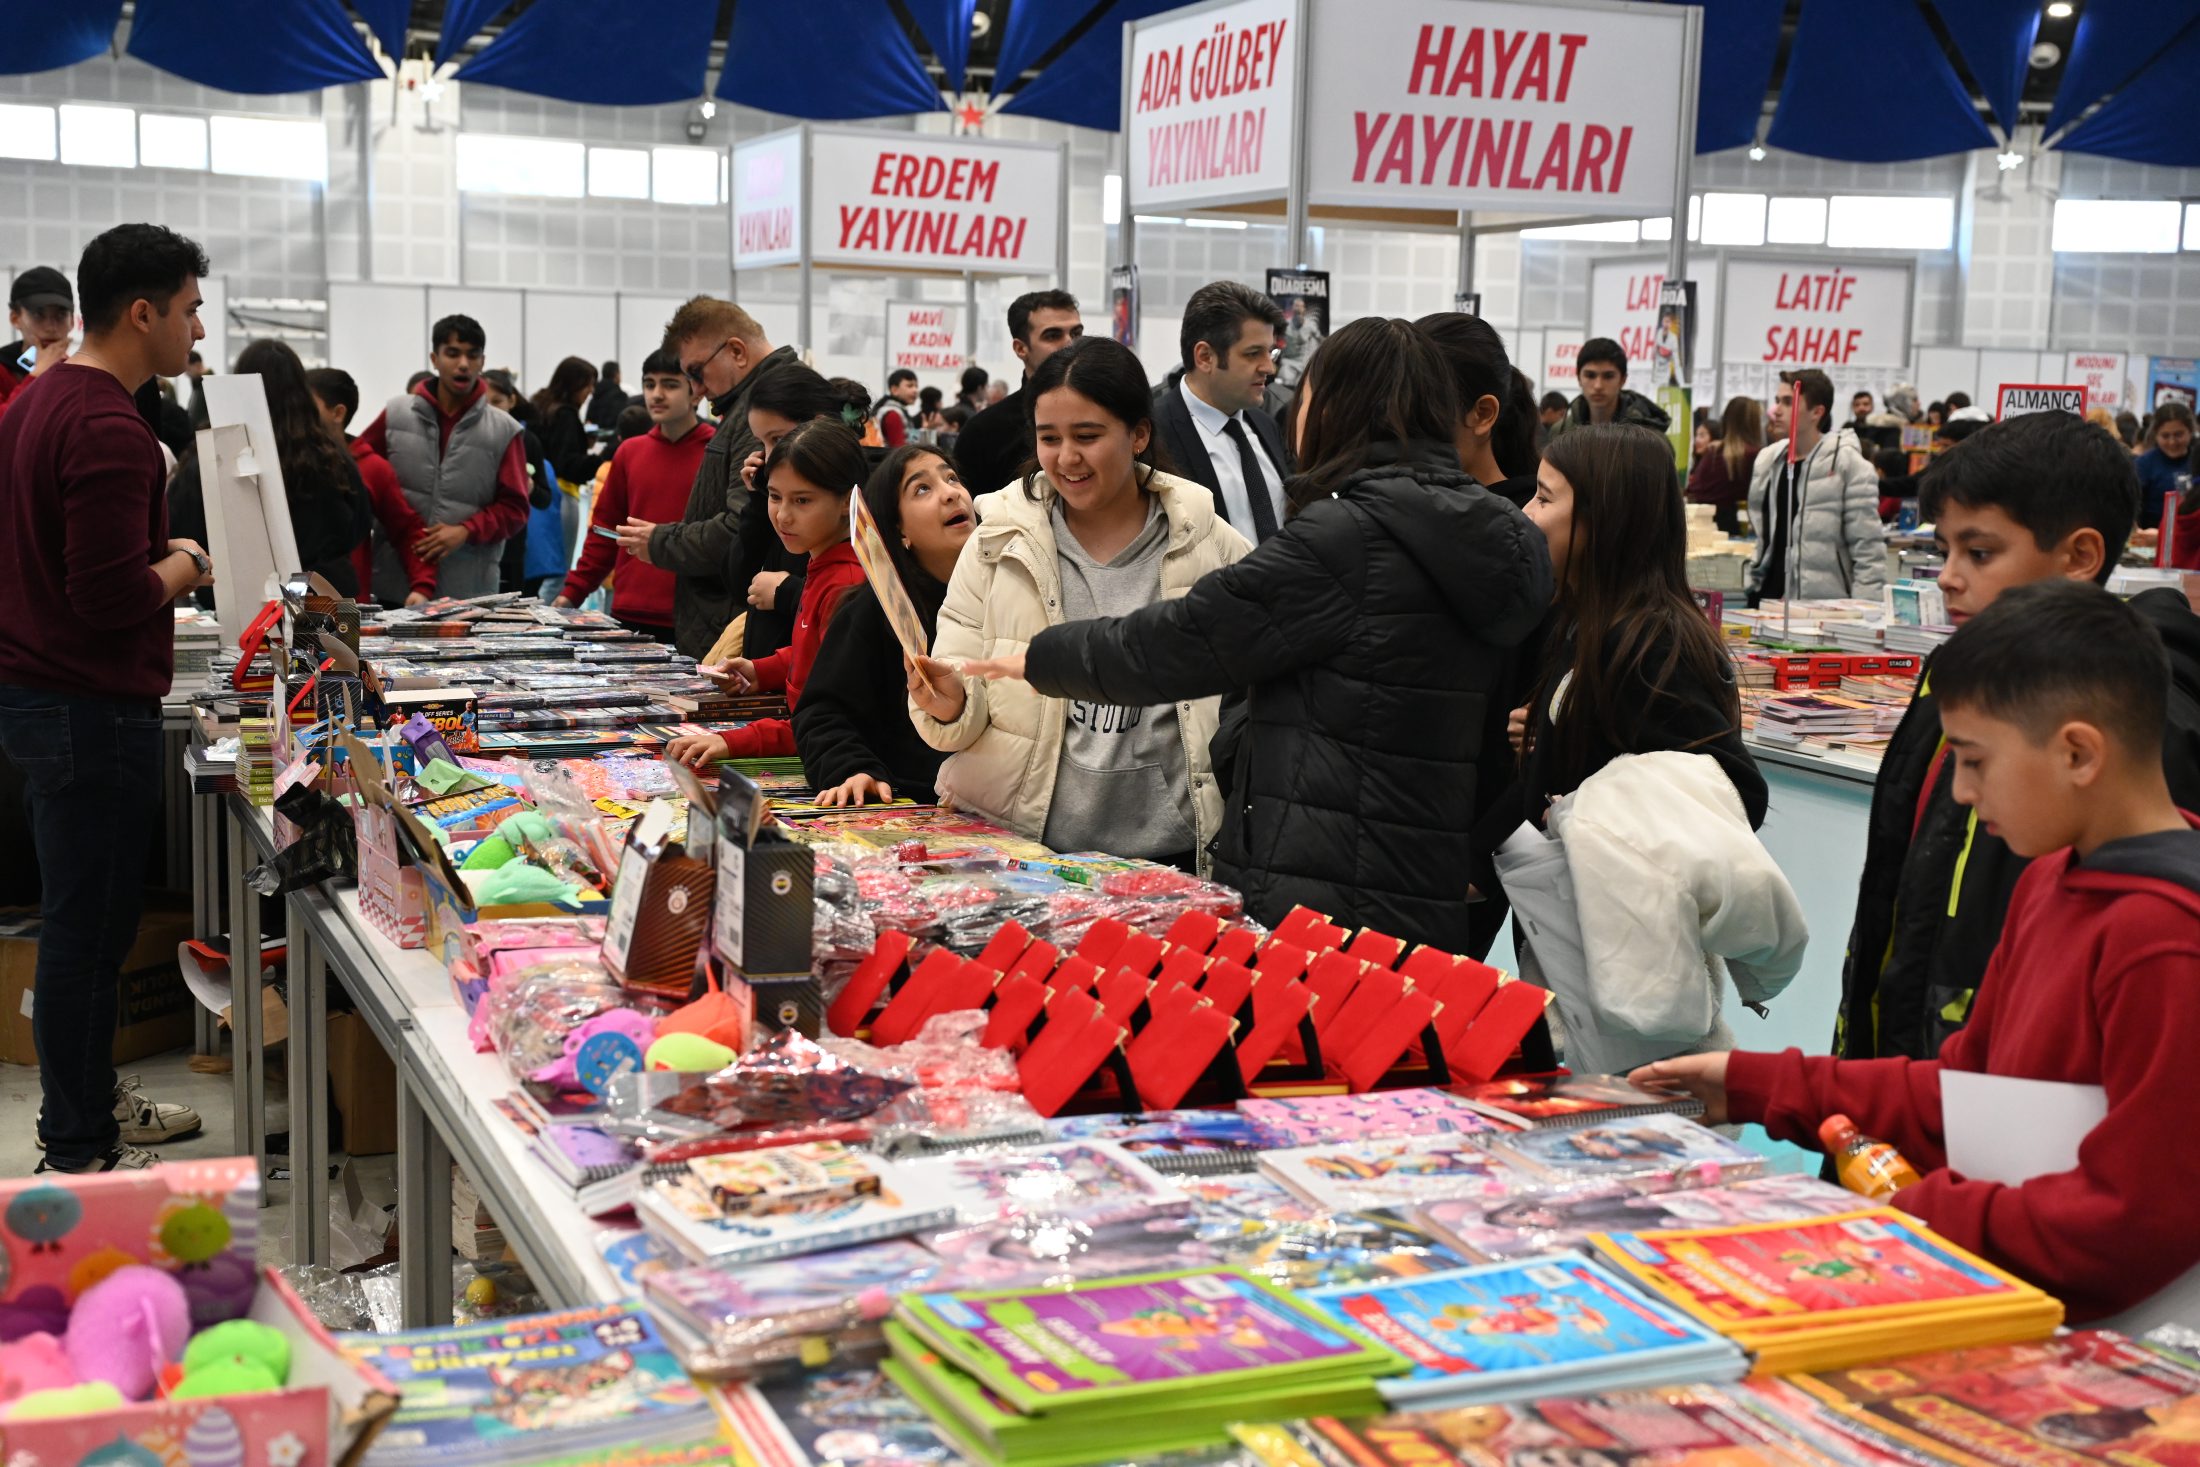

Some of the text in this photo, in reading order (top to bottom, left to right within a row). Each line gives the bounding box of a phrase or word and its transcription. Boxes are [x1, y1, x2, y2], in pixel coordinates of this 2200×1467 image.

[1136, 19, 1287, 114] ADA GÜLBEY
[1407, 24, 1588, 102] HAYAT
[1147, 107, 1266, 188] YAYINLARI
[1351, 111, 1634, 193] YAYINLARI
[871, 152, 1000, 203] ERDEM
[738, 204, 794, 255] YAYINLARI
[838, 205, 1027, 260] YAYINLARI
[1270, 277, 1327, 297] QUARESMA
[1626, 274, 1664, 311] LAT
[1775, 267, 1857, 312] LATİF
[907, 308, 944, 326] MAVİ
[908, 331, 953, 347] KADIN
[1620, 326, 1656, 361] SAH
[1762, 325, 1862, 364] SAHAF
[2005, 390, 2081, 410] ALMANCA
